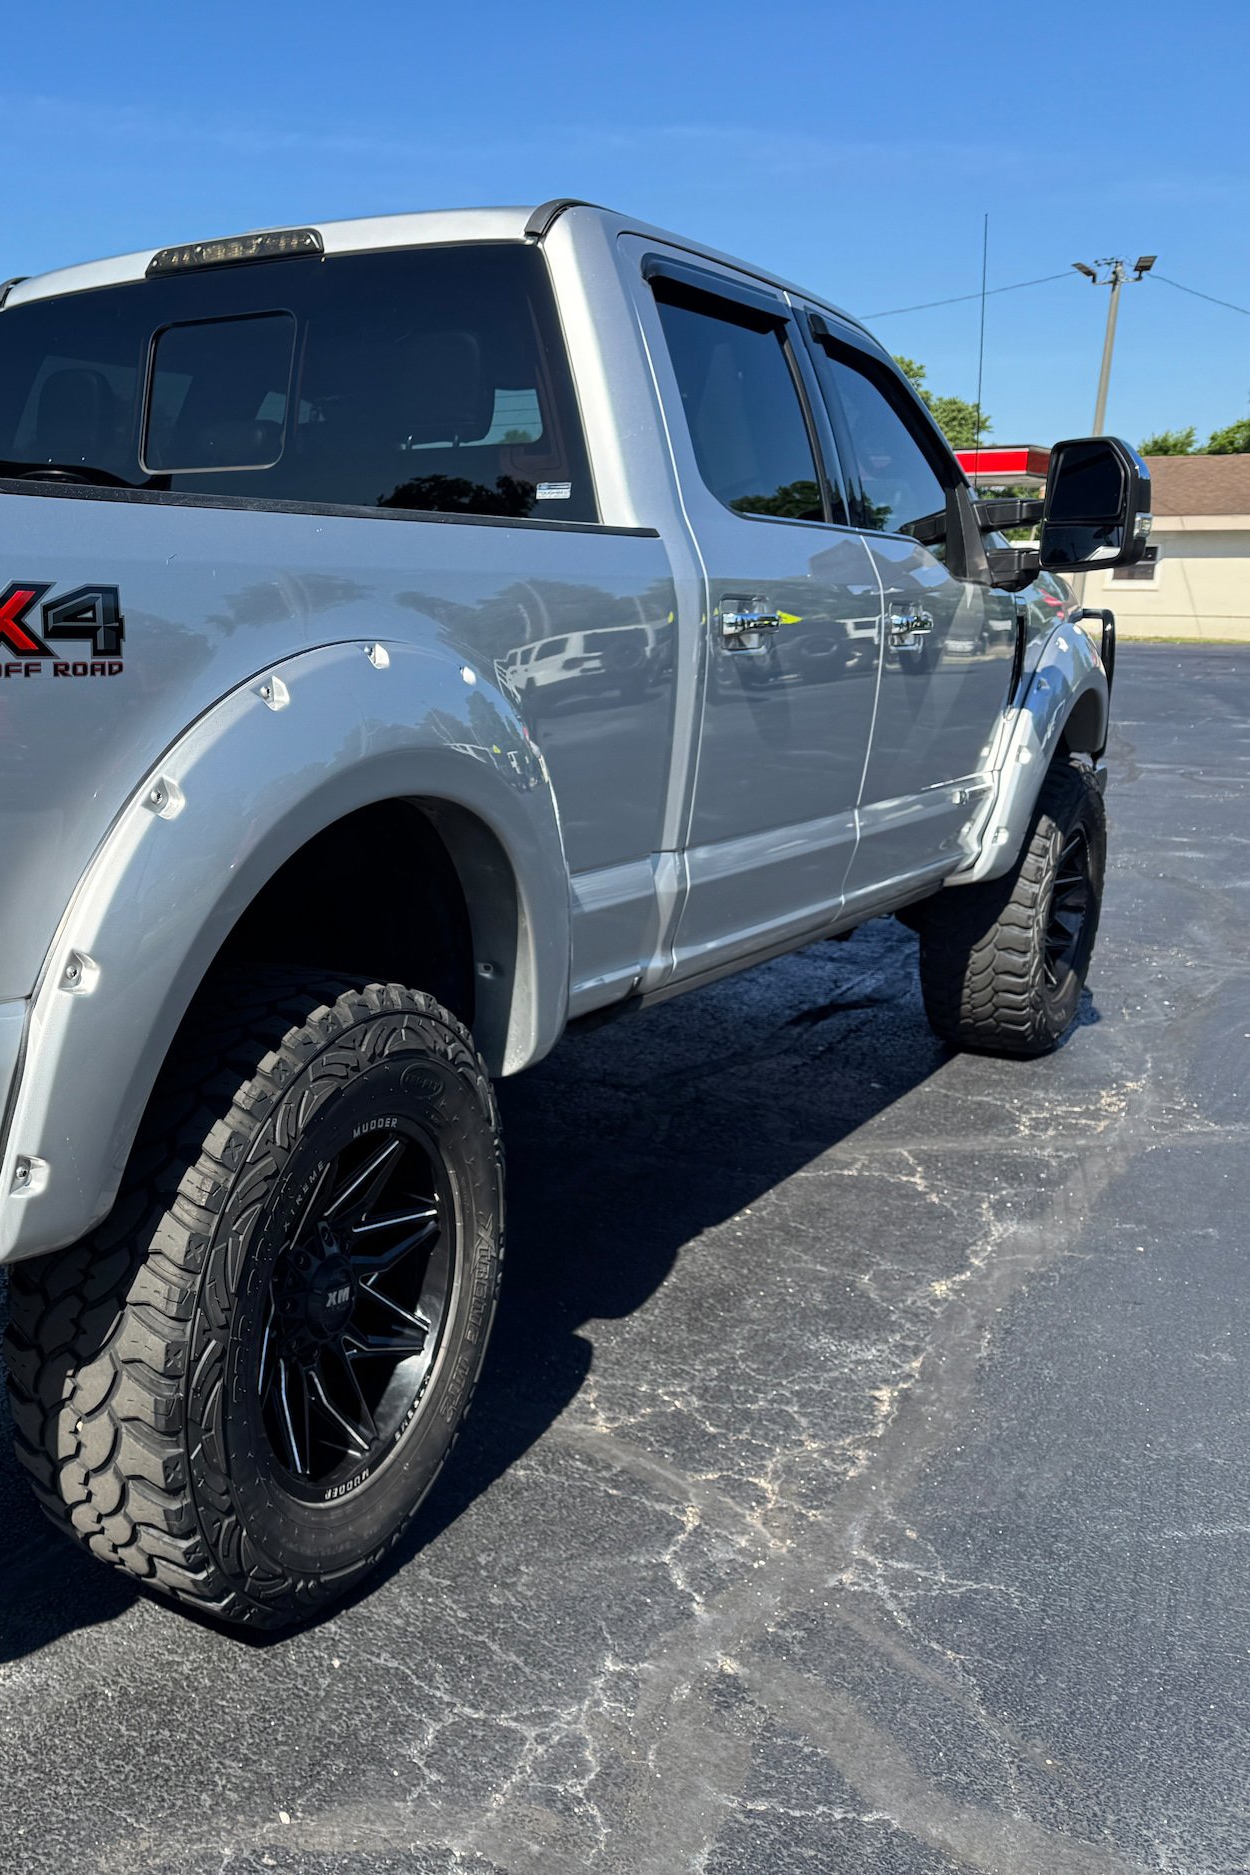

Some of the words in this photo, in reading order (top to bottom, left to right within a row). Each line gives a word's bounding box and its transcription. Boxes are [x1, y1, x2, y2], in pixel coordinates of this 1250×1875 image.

[52, 660, 123, 678] ROAD
[352, 1117, 398, 1139] MUDDER
[326, 1286, 350, 1307] XM
